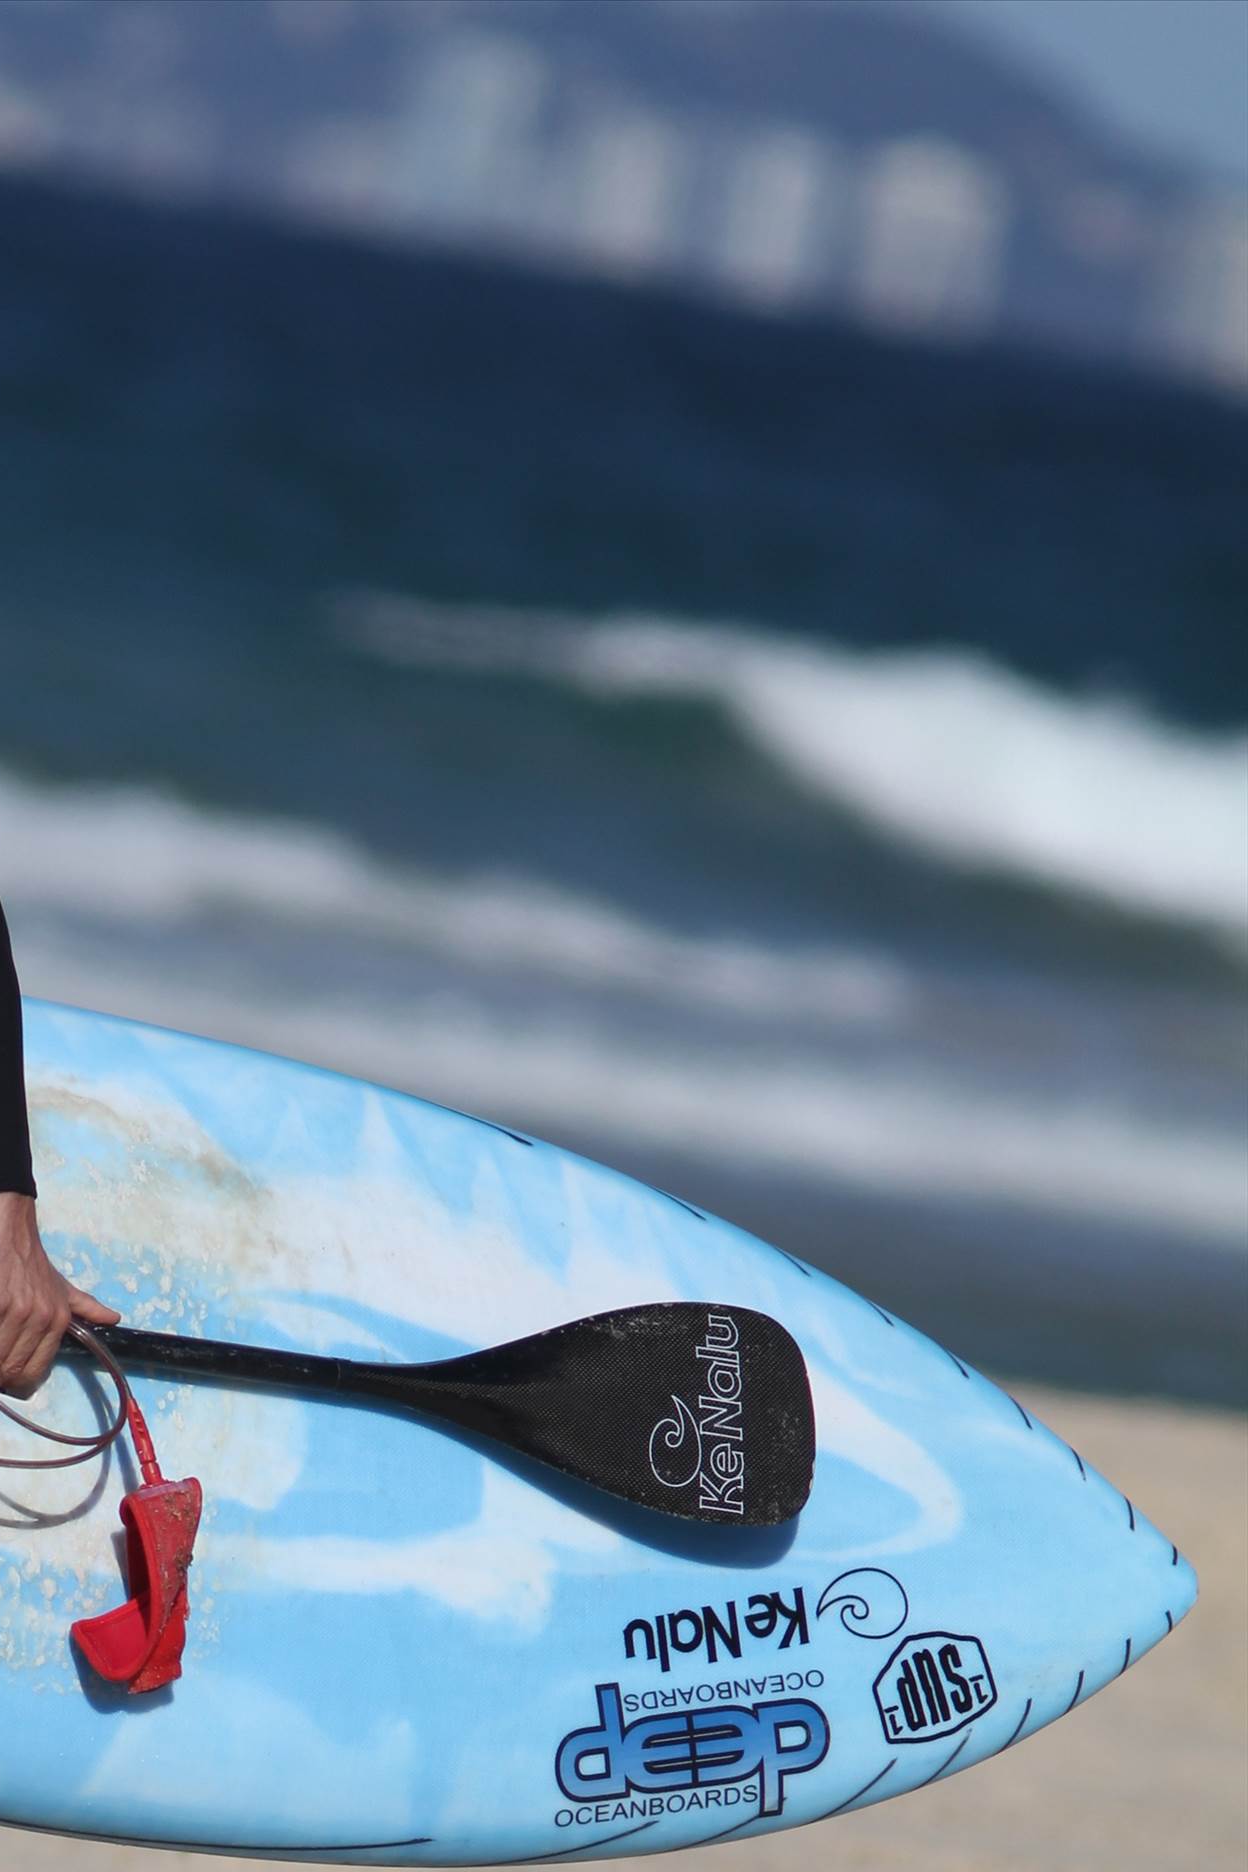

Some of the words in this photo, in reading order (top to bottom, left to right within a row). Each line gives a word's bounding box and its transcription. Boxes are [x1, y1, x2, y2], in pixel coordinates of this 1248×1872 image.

[623, 1669, 825, 1713] OCEANBOARDS
[896, 1642, 974, 1732] SUP
[554, 1682, 831, 1819] deep
[554, 1784, 759, 1829] OCEANBOARDS
